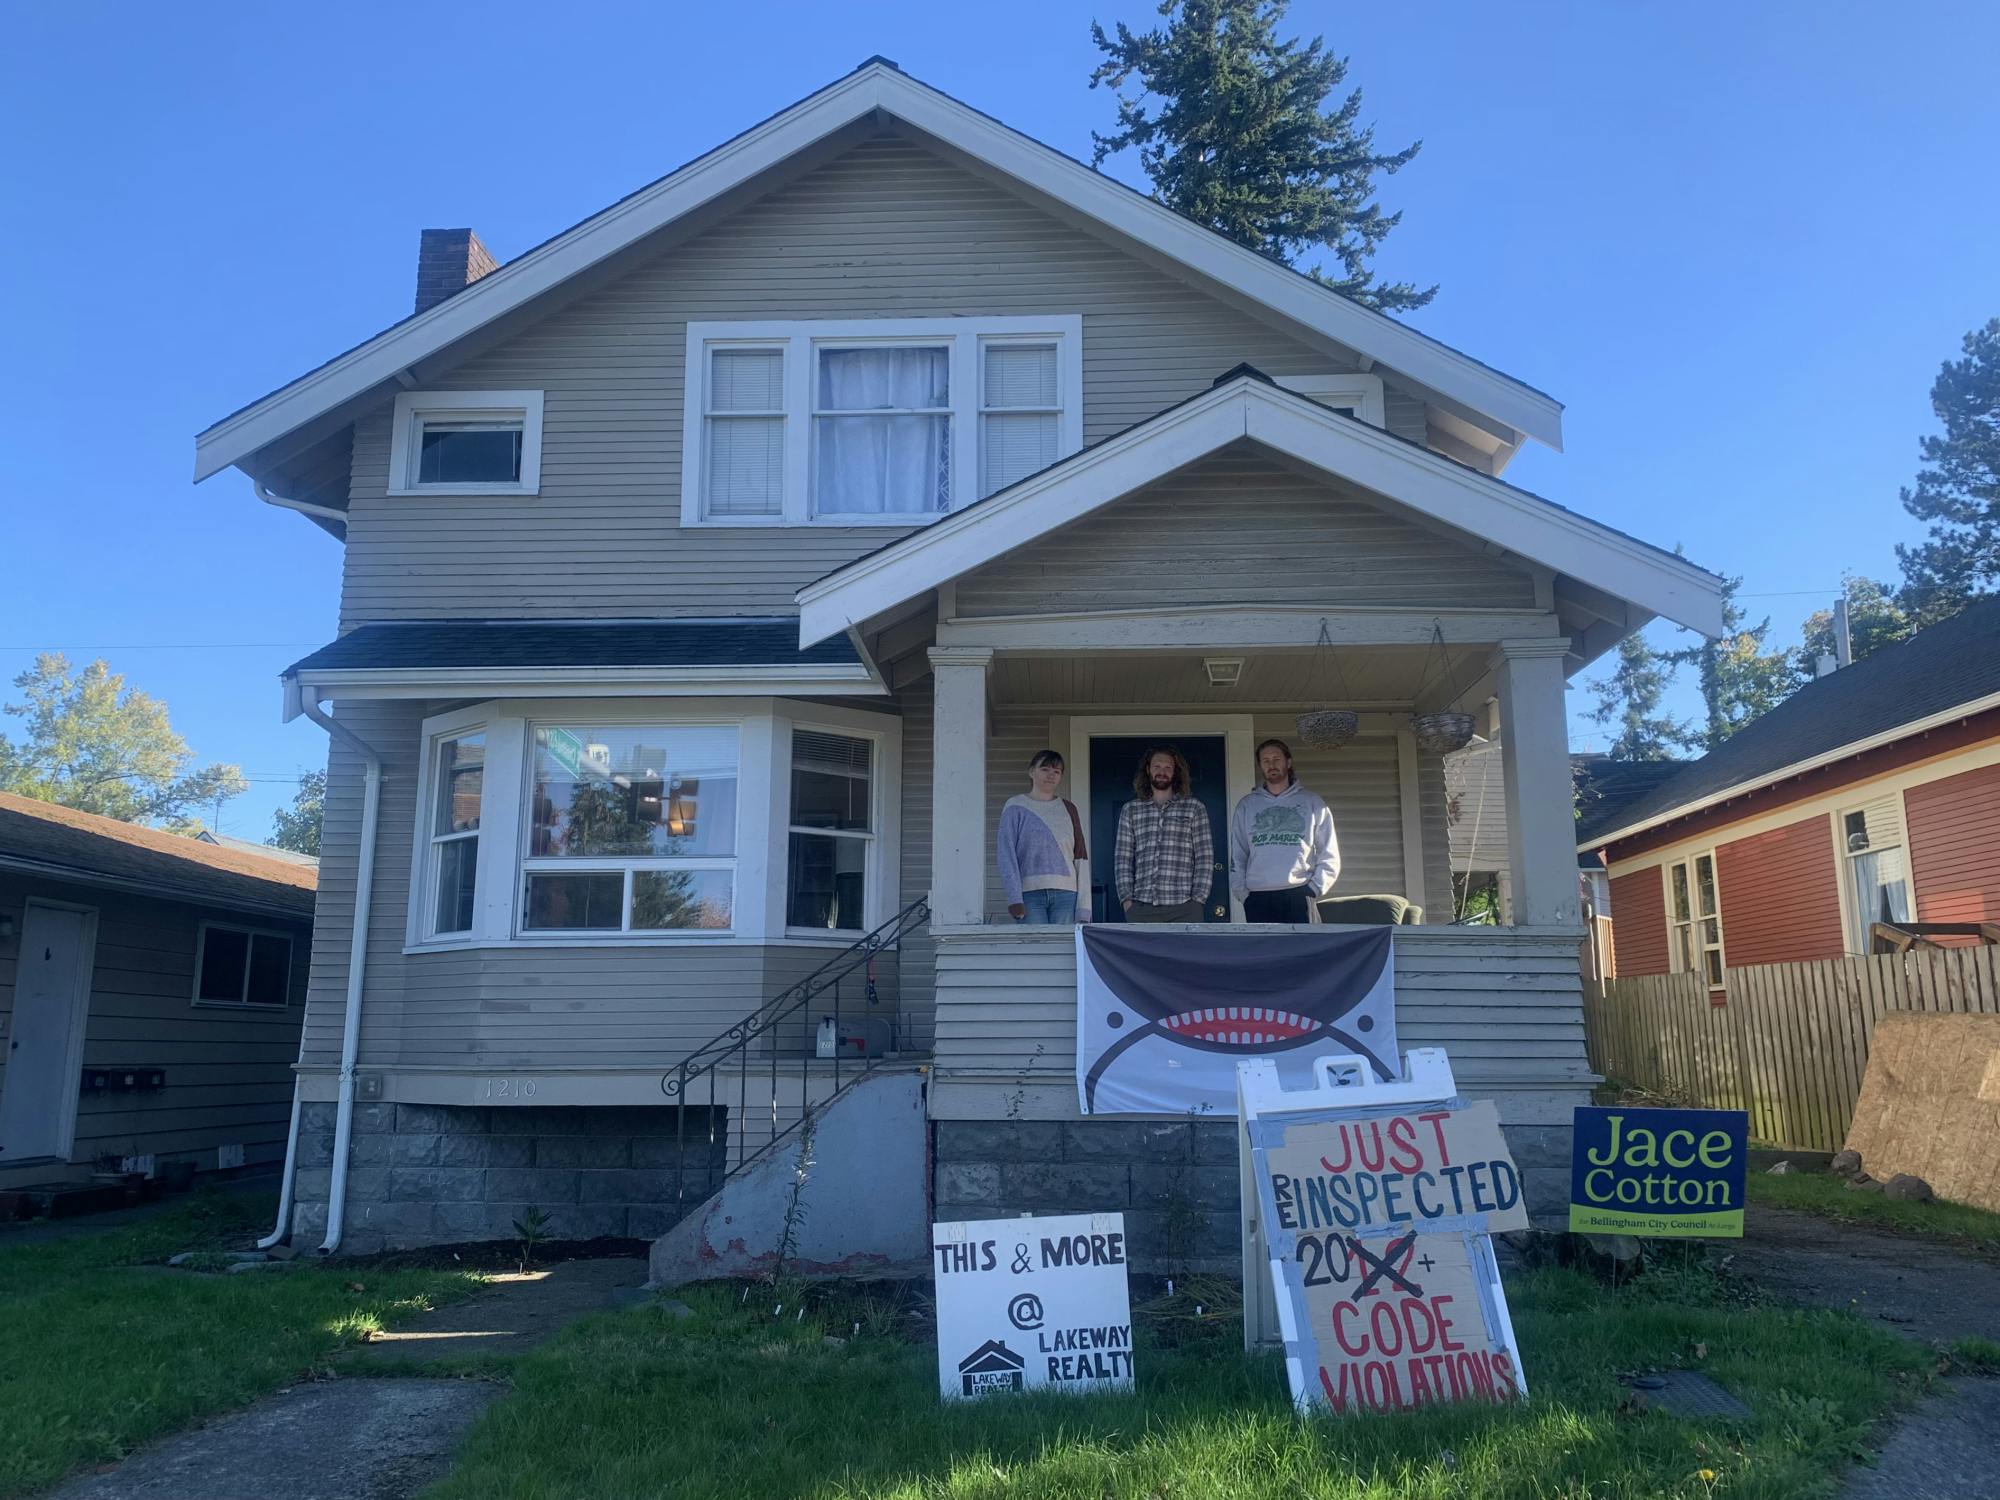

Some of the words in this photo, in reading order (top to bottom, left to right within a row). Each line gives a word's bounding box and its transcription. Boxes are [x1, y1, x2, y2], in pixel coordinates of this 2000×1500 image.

[485, 1079, 537, 1099] 1210
[1319, 1112, 1451, 1175] JUST
[1587, 1116, 1733, 1169] Jace
[1292, 1160, 1519, 1230] INSPECTED
[1584, 1168, 1731, 1205] Cotton
[1590, 1216, 1646, 1229] Bellingham
[1648, 1219, 1668, 1231] City
[1671, 1220, 1707, 1230] Council
[935, 1240, 997, 1274] THIS
[1010, 1242, 1035, 1275] &
[1040, 1232, 1125, 1269] MORE
[1007, 1293, 1044, 1331] @
[1333, 1295, 1465, 1357] CODE
[1038, 1325, 1130, 1353] LAKEWAY
[972, 1372, 1012, 1385] LAKEWAY
[1047, 1350, 1135, 1381] REALTY
[1319, 1349, 1517, 1416] VIOLATIONS
